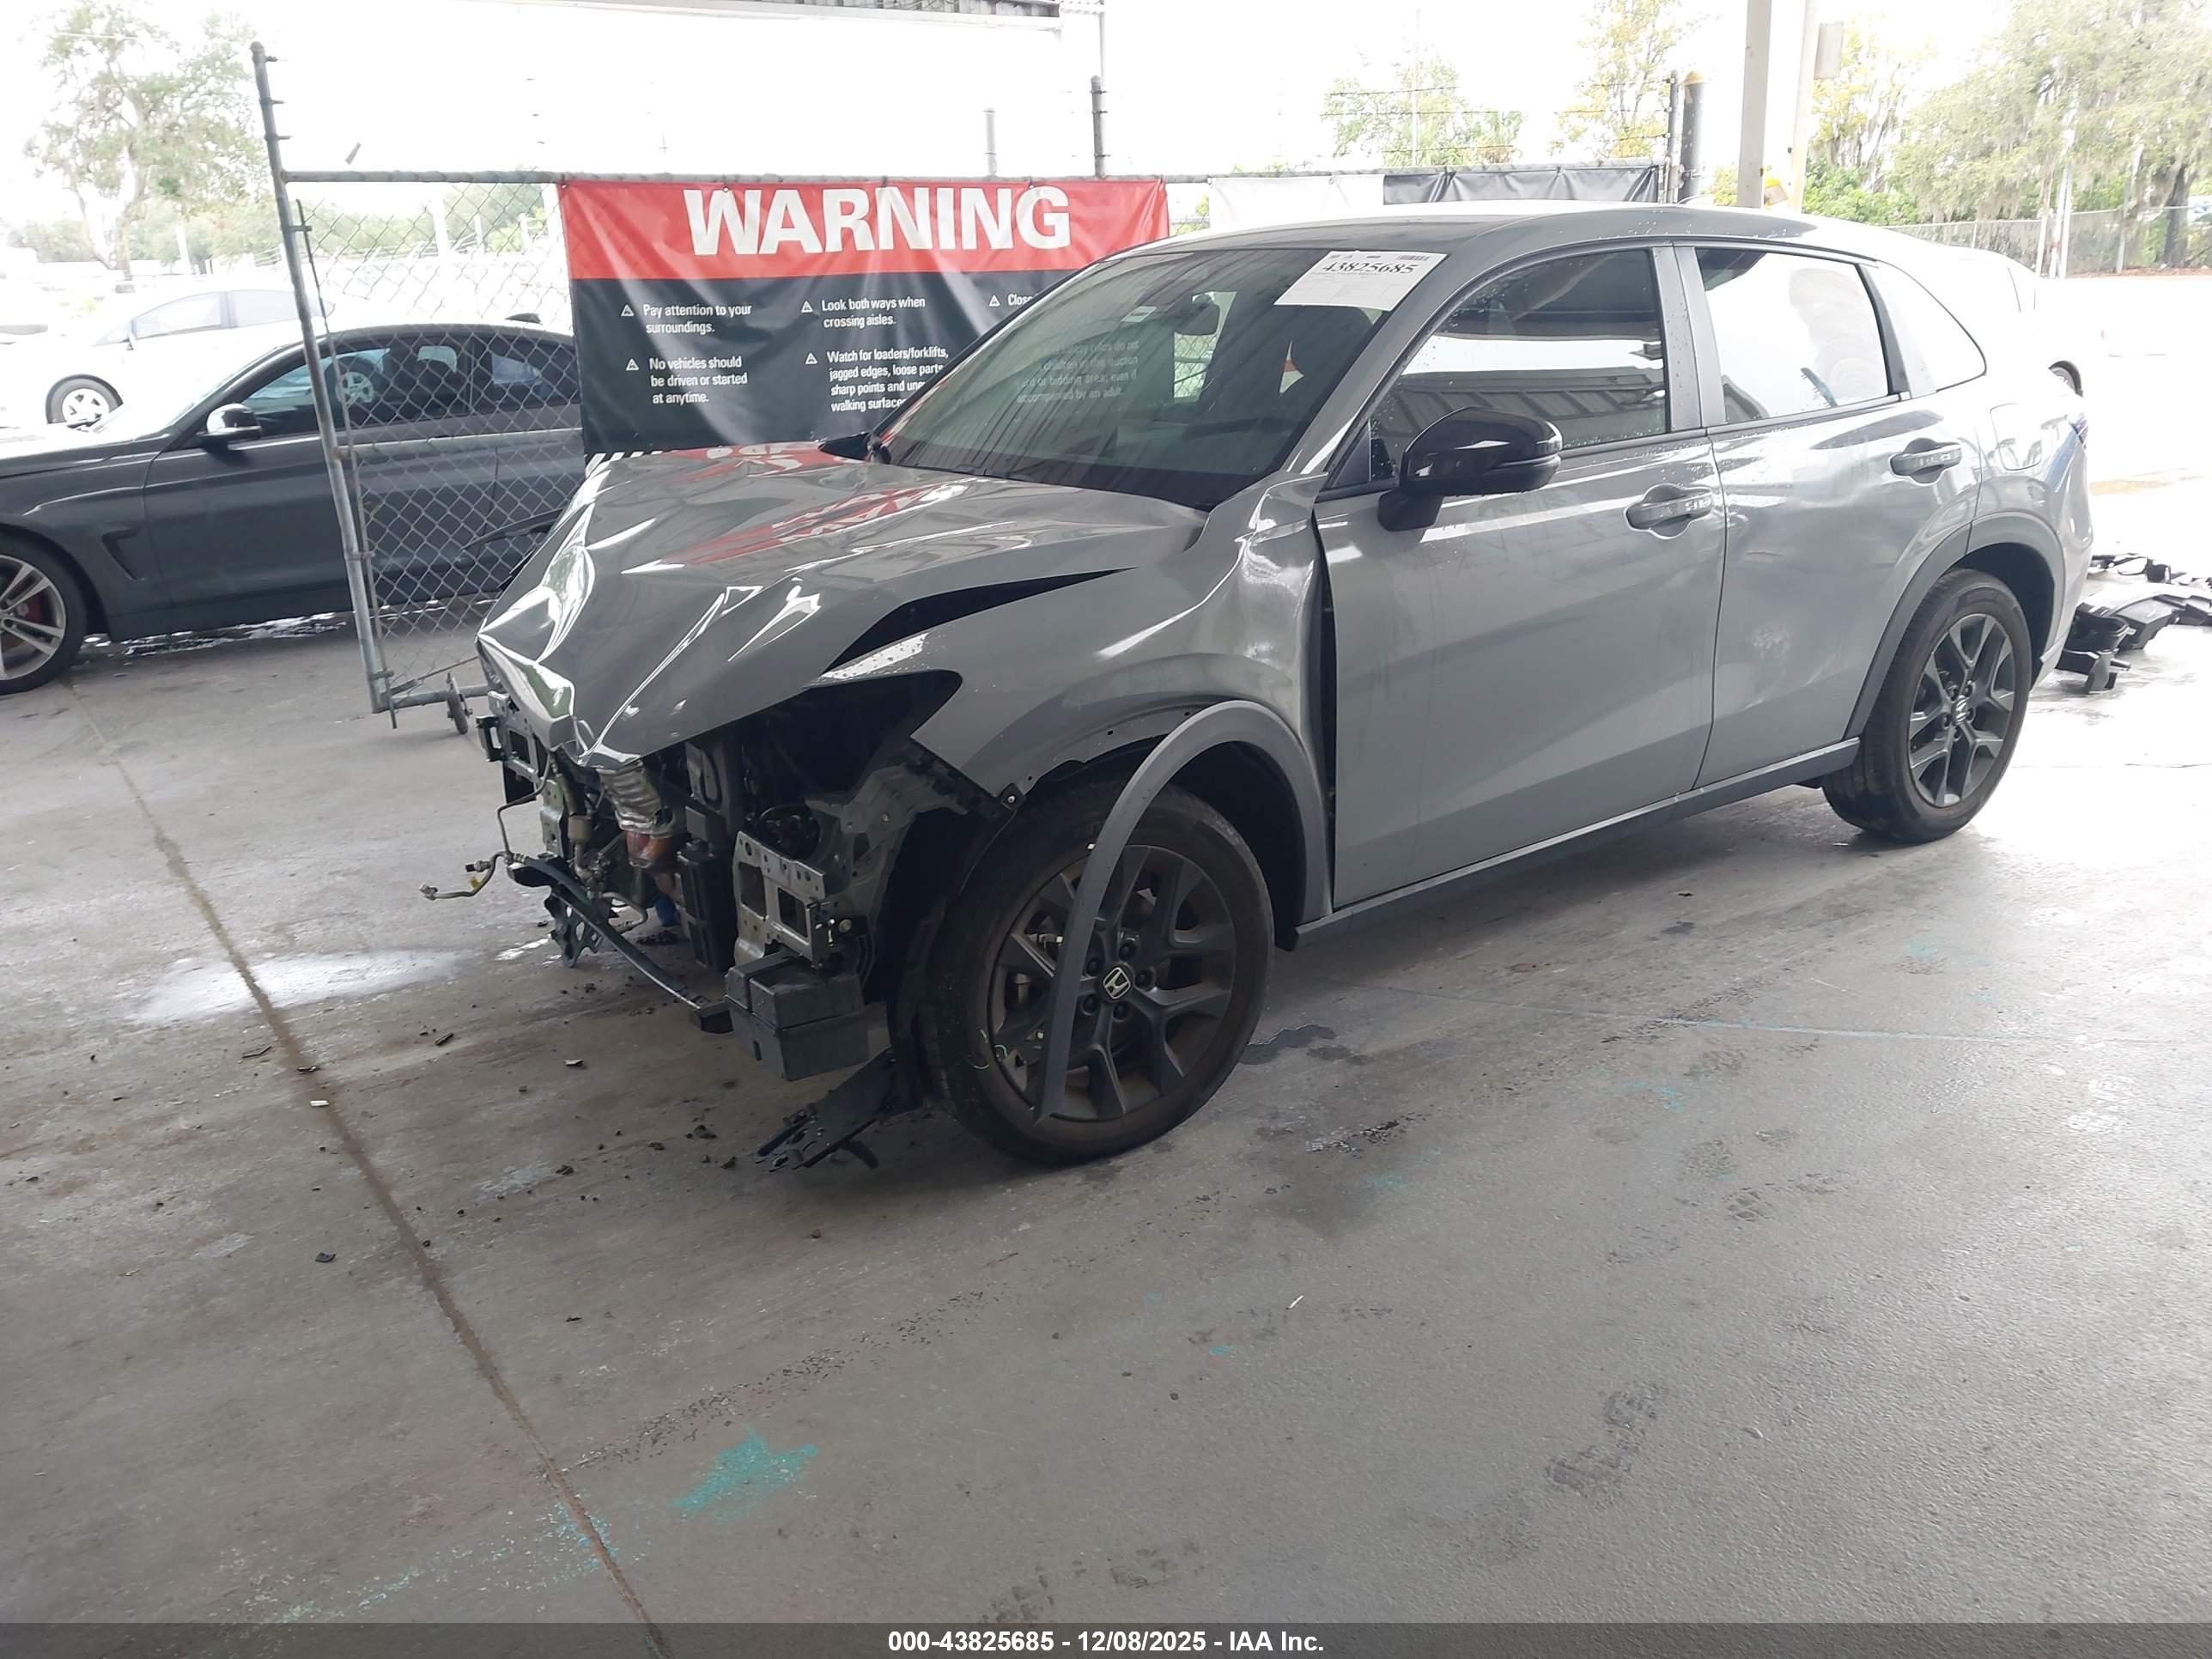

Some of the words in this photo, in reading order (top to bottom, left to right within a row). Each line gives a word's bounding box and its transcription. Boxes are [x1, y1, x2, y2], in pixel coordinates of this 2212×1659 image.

[684, 186, 1071, 255] WARNING
[1323, 261, 1419, 274] 43825685
[643, 303, 662, 318] Pay
[665, 304, 714, 316] attention
[715, 305, 726, 315] to
[728, 305, 752, 318] your
[822, 299, 847, 312] Look
[848, 297, 870, 310] both
[871, 299, 897, 312] ways
[897, 296, 926, 308] when
[646, 320, 715, 335] surroundings.
[823, 315, 865, 329] crossing
[866, 313, 896, 325] aisles.
[827, 349, 858, 363] Watch
[859, 349, 872, 362] for
[874, 345, 949, 360] loaders/forklifts,
[649, 357, 665, 370] No
[667, 357, 707, 369] vehicles
[708, 356, 742, 368] should
[651, 375, 665, 387] be
[667, 374, 698, 386] driven
[699, 376, 709, 386] or
[712, 373, 748, 386] started
[830, 367, 859, 382] jagged
[860, 365, 891, 378] edges,
[892, 364, 916, 376] loose
[830, 384, 856, 398] sharp
[858, 382, 885, 397] points
[887, 380, 905, 392] and
[652, 393, 664, 404] at
[665, 392, 710, 406] anytime.
[831, 398, 866, 412] walking
